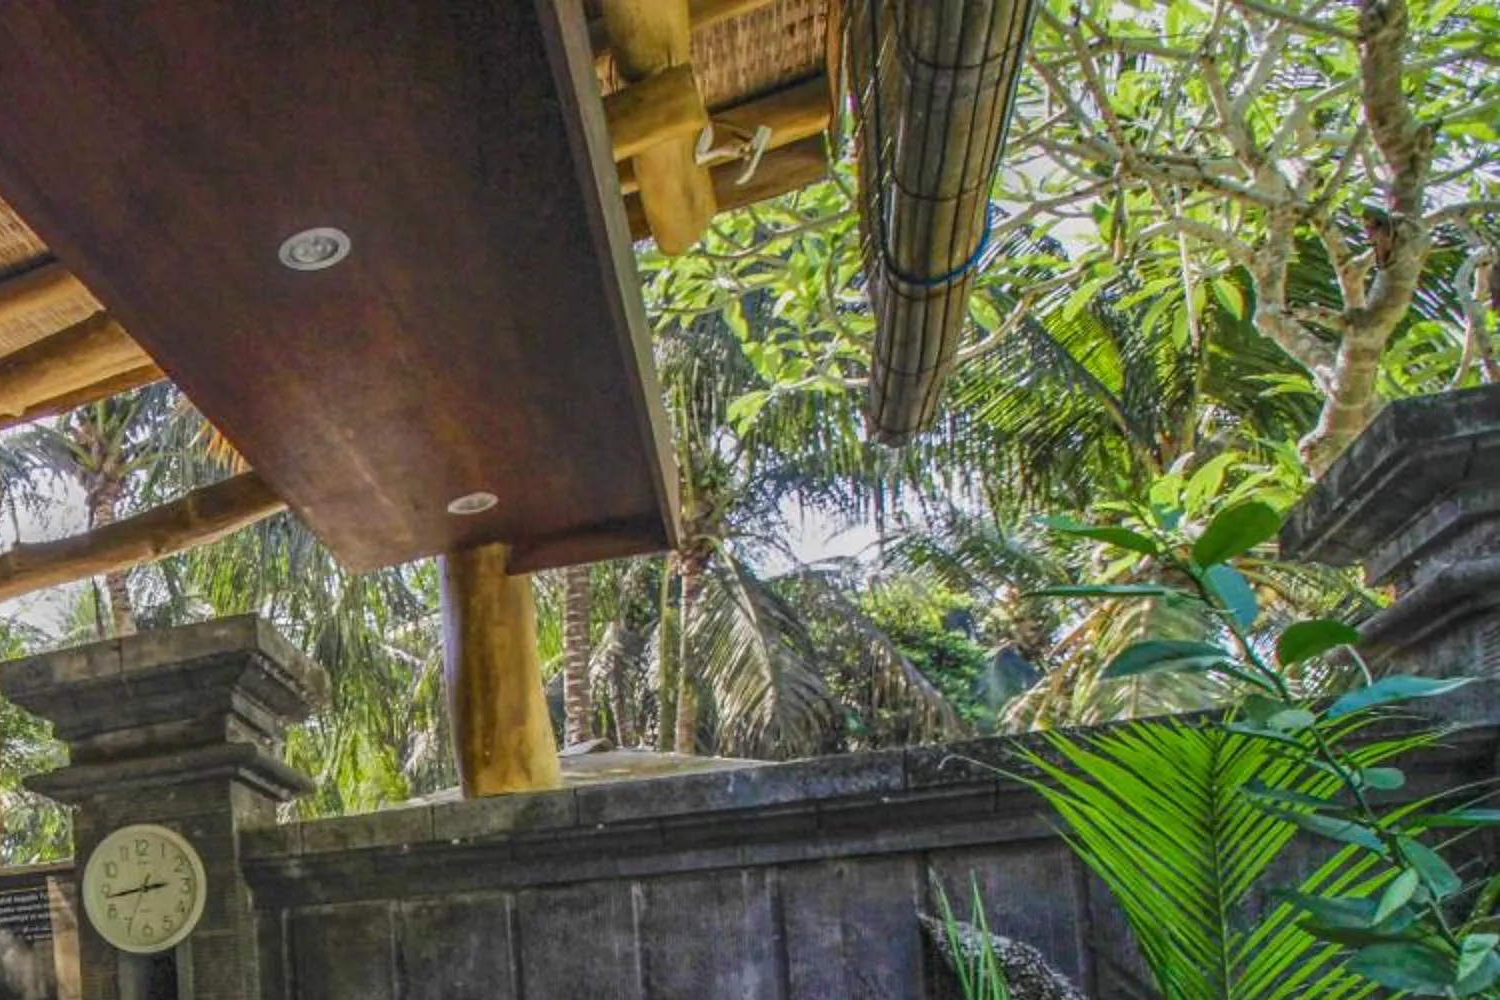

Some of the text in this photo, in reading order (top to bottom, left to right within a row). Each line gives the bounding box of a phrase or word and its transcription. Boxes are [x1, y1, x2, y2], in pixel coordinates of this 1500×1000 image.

[135, 839, 149, 856] 12
[104, 861, 118, 878] 10
[180, 877, 191, 894] 3
[142, 921, 154, 937] 6
[162, 915, 173, 932] 5
